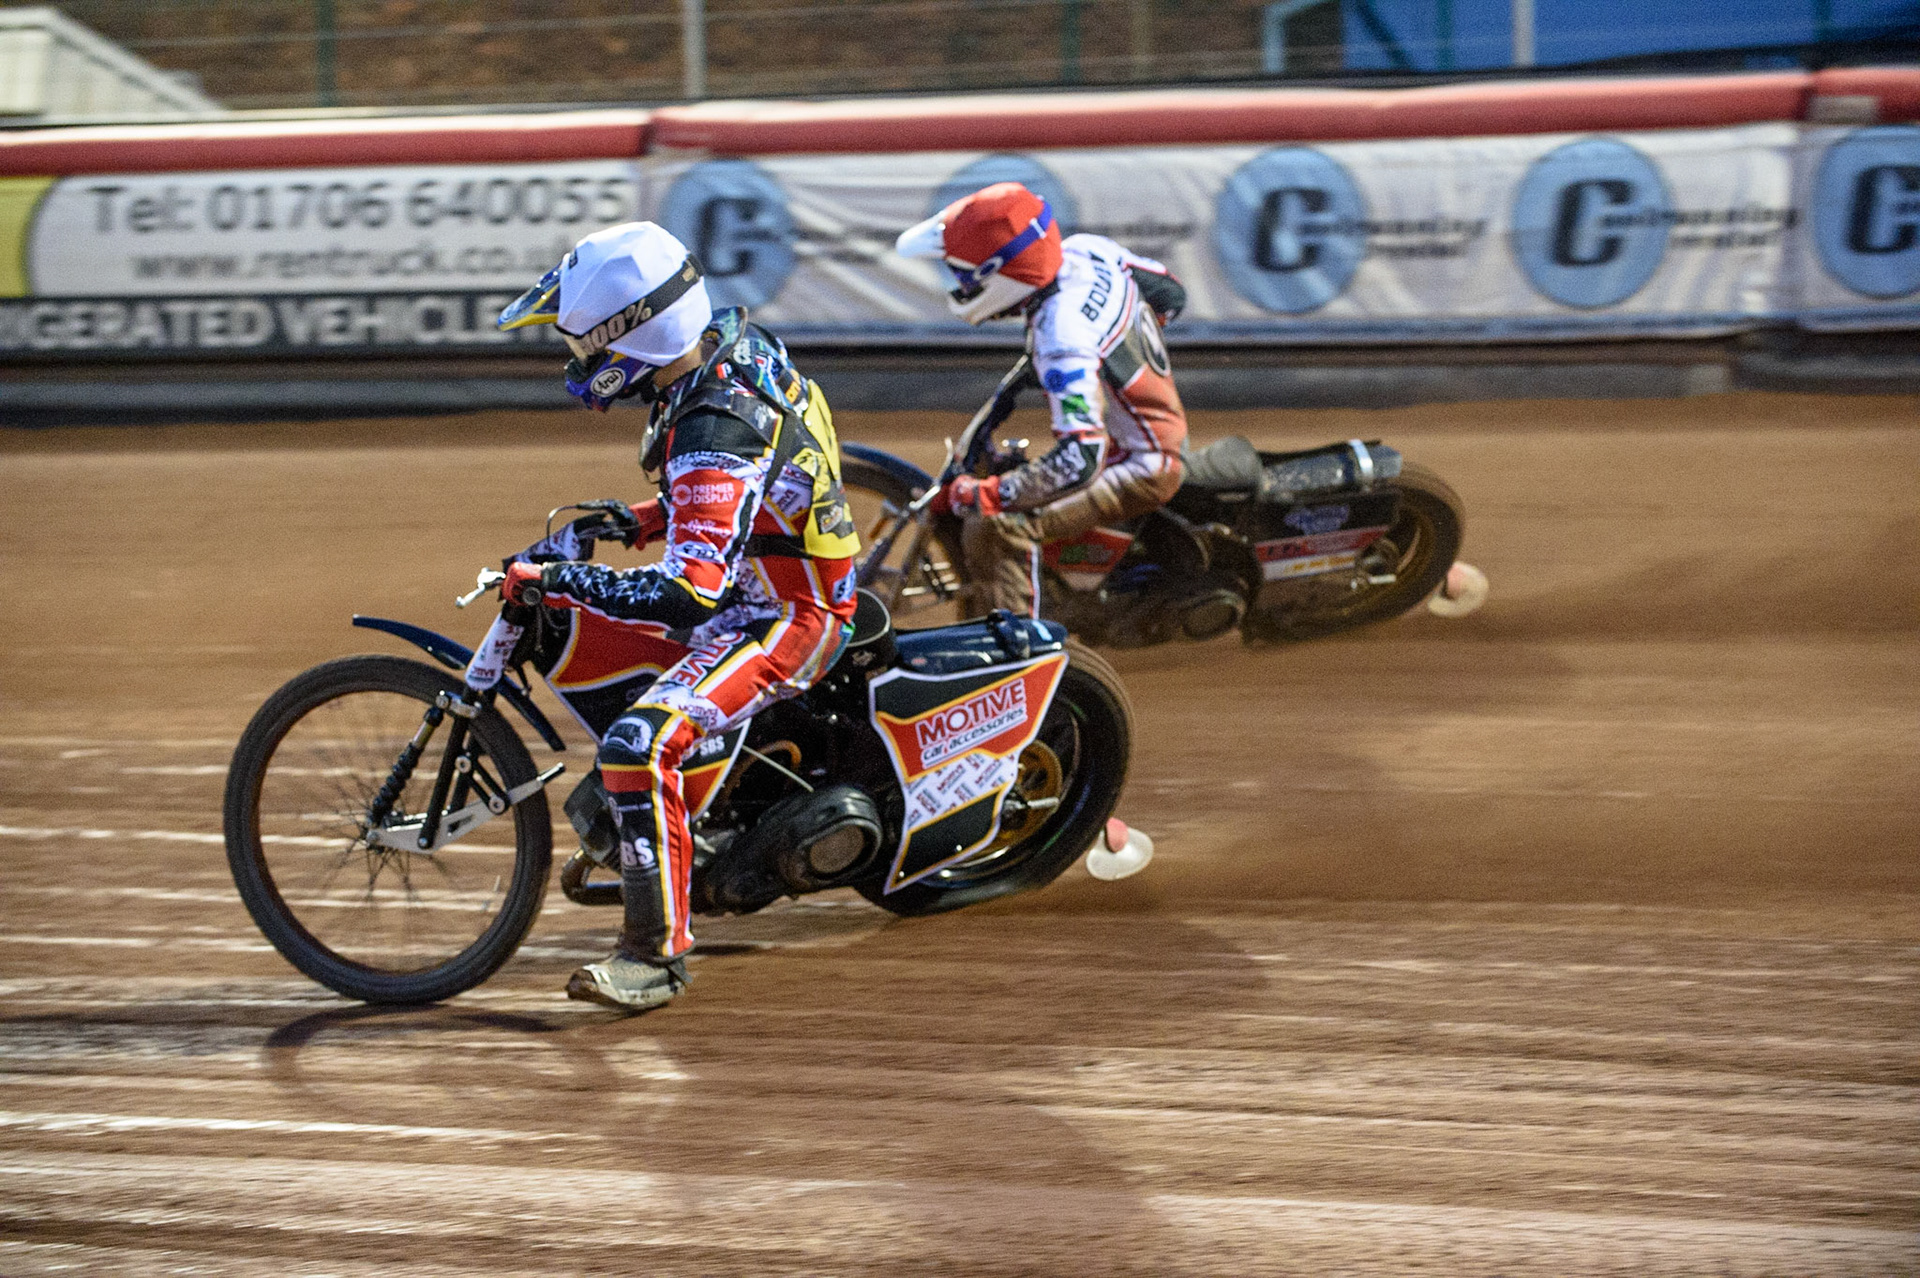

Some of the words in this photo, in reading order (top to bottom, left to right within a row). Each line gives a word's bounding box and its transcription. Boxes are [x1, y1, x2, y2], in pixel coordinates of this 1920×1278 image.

[204, 180, 388, 231] 01706
[406, 176, 627, 228] 640055
[692, 483, 735, 497] PREMIER
[692, 491, 735, 505] DISPLAY
[917, 680, 1024, 746] MOTIVE
[699, 735, 725, 758] SBS
[923, 744, 943, 761] car
[949, 708, 1024, 750] accessories
